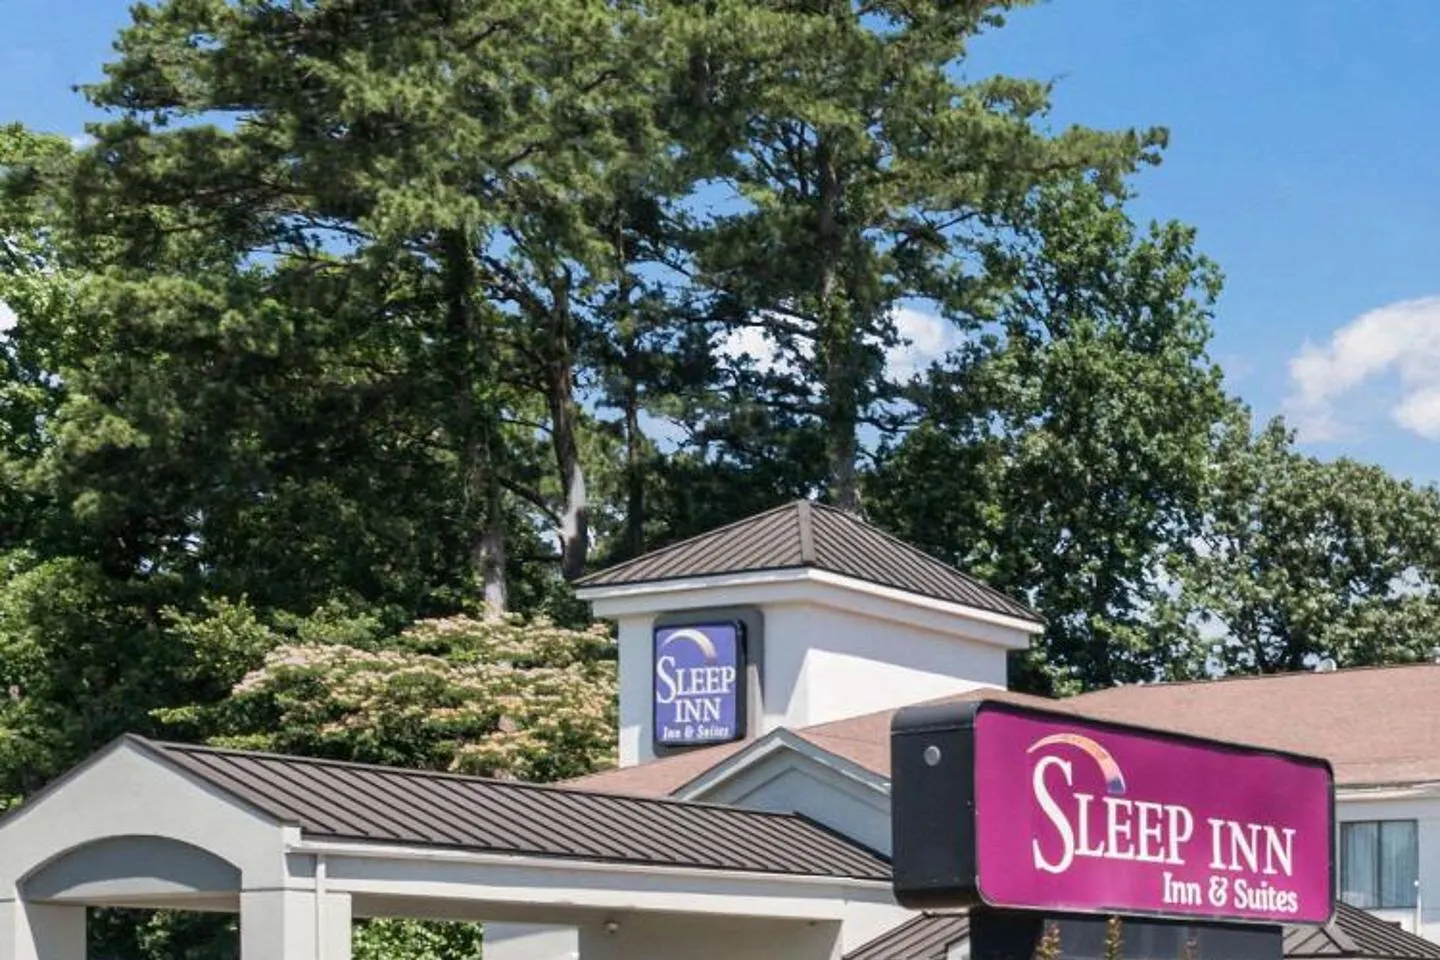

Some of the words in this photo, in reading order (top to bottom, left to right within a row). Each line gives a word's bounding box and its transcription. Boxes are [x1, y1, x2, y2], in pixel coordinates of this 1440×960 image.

[675, 698, 721, 723] INN
[663, 726, 682, 739] Inn
[684, 725, 695, 738] &
[697, 724, 729, 738] Suites
[1208, 819, 1296, 876] INN
[1164, 872, 1202, 905] Inn
[1209, 876, 1229, 907] &
[1234, 880, 1298, 913] Suites
